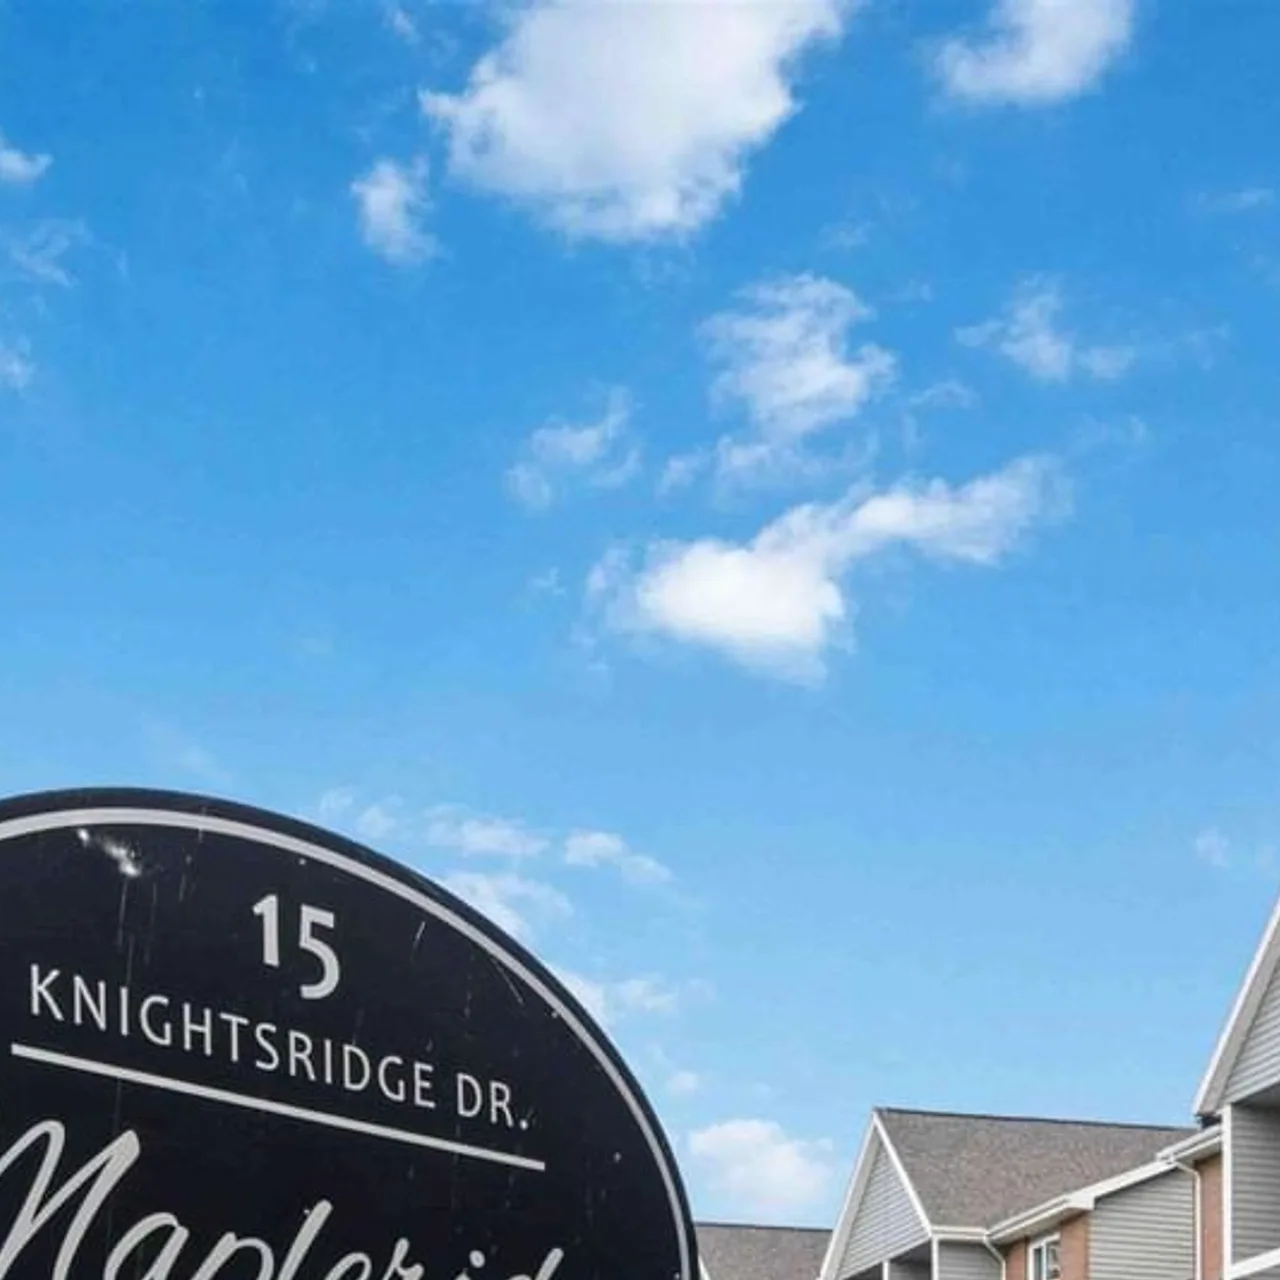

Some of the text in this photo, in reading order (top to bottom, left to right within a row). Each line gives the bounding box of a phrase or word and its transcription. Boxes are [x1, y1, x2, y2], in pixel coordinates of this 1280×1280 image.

[252, 894, 341, 1000] 15
[30, 963, 530, 1130] KNIGHTSRIDGE DR.
